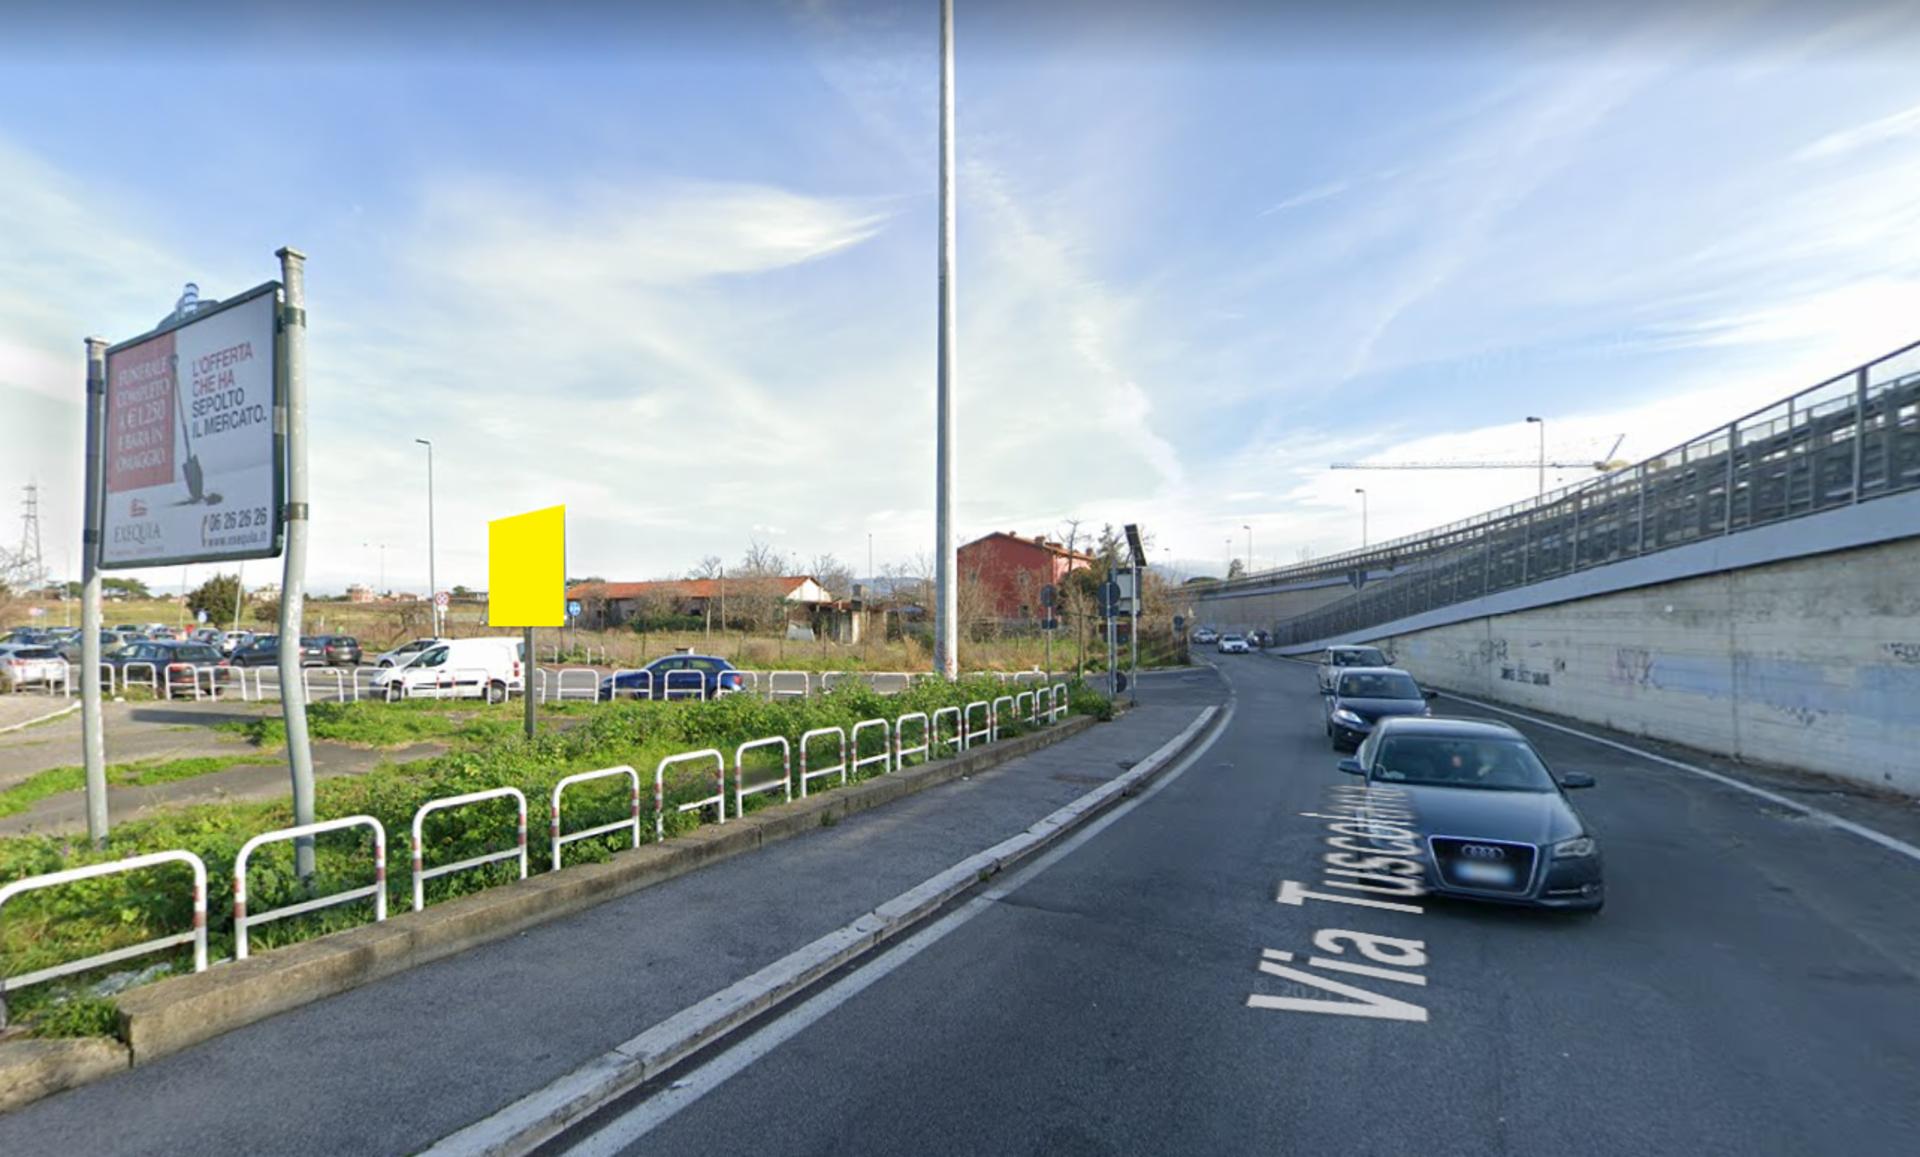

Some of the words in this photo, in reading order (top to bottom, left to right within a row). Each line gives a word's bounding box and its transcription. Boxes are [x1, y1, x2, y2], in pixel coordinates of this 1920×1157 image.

[192, 341, 253, 377] L'OFFERTA
[192, 374, 216, 397] CHE
[218, 369, 235, 390] HA
[192, 387, 245, 418] SEPOLTO
[192, 420, 202, 439] IL
[204, 404, 267, 435] MERCATO.
[114, 522, 161, 545] EXEQUIA
[209, 512, 221, 531] 06
[224, 511, 237, 530] 26
[239, 509, 251, 528] 26
[253, 507, 268, 526] 26
